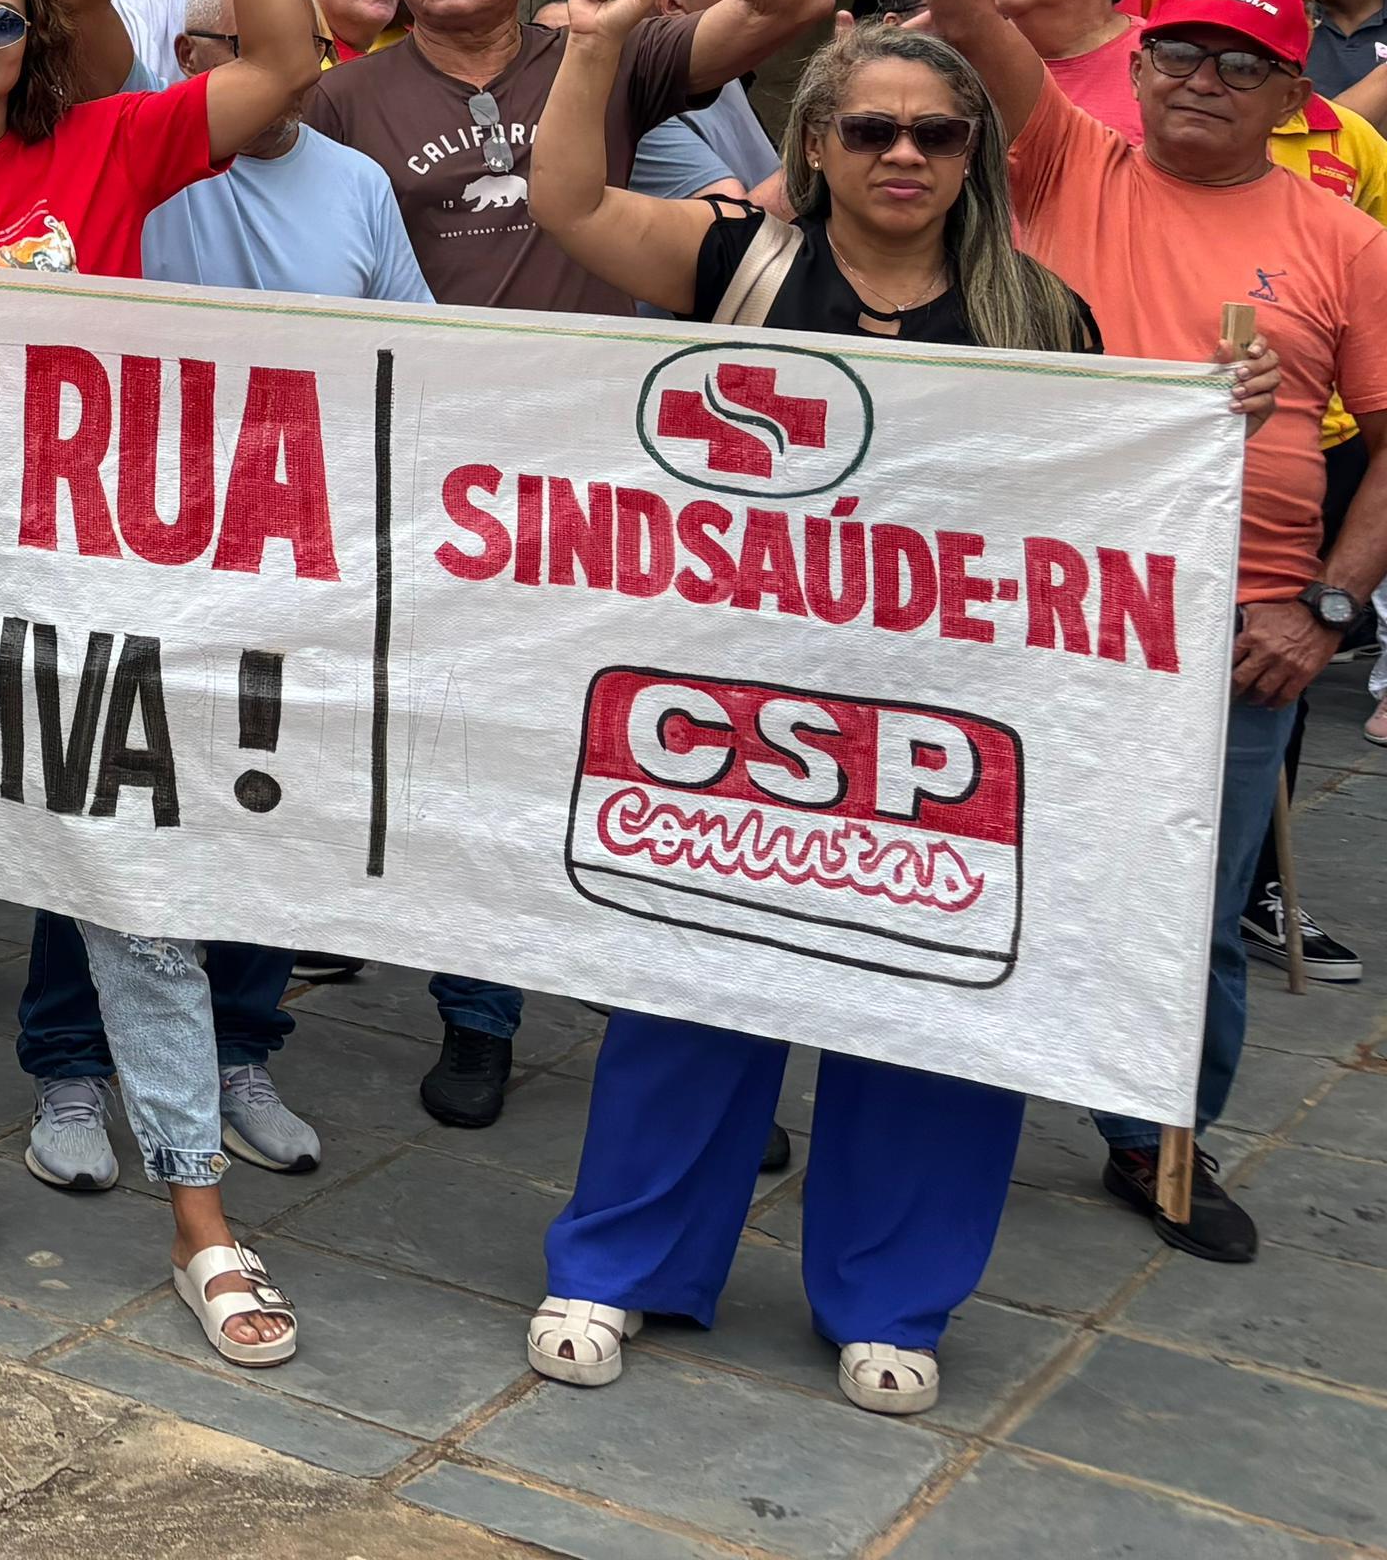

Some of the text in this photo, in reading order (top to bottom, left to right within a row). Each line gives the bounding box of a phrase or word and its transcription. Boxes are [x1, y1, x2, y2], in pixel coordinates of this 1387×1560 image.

[407, 123, 538, 175] CALIFOR
[20, 343, 341, 582] RUA
[433, 463, 1181, 675] SINDSAÚDE-RN
[627, 682, 983, 820] CSP
[597, 786, 985, 913] Conlutas
